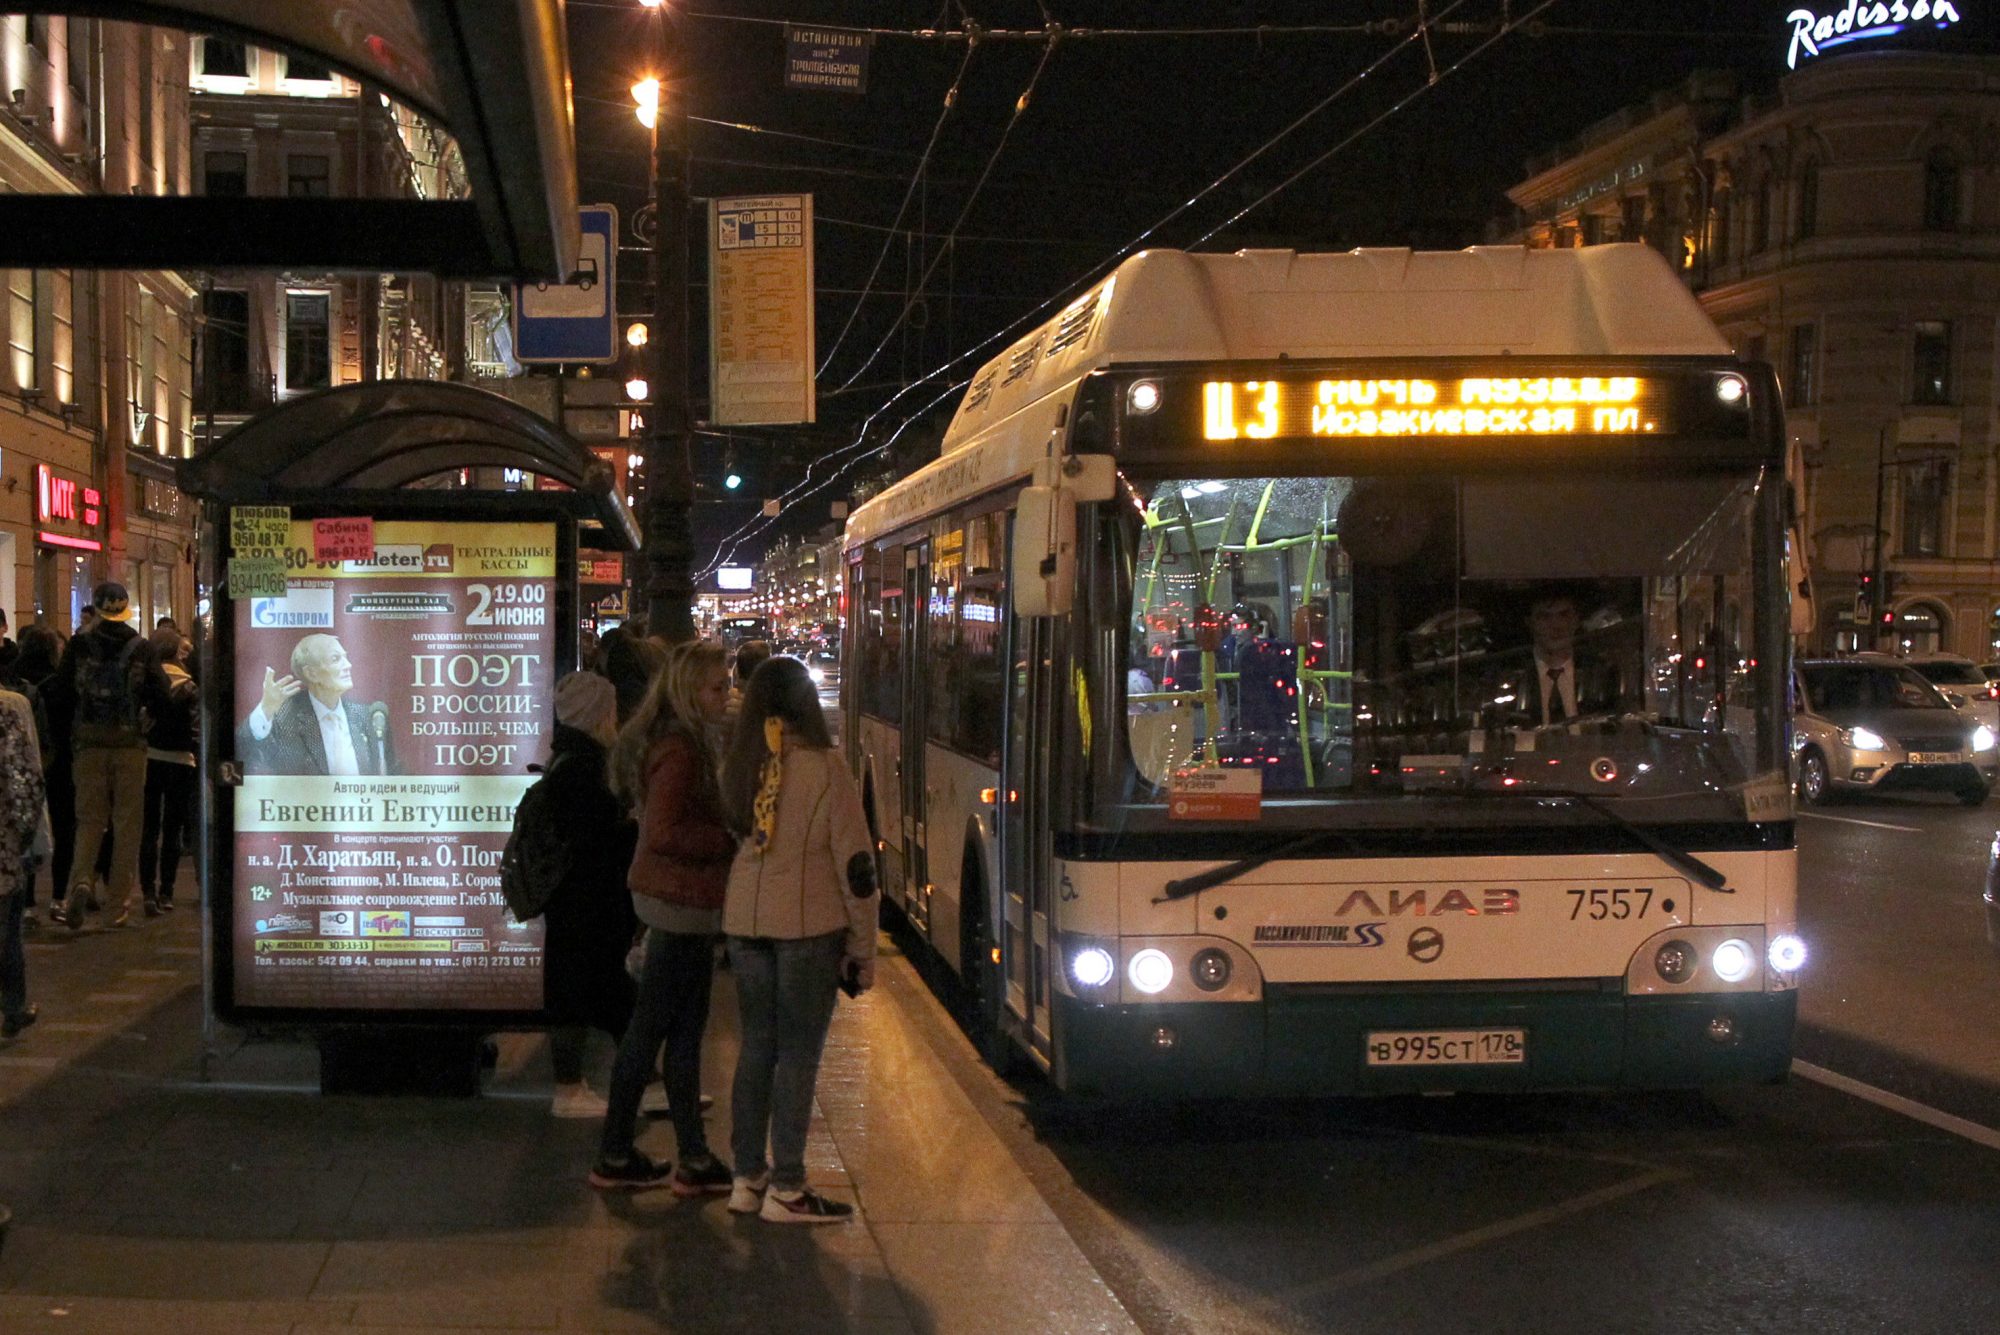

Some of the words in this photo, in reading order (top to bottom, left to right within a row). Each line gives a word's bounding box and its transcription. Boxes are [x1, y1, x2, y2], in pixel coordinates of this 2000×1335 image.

[1787, 0, 1960, 70] Radisson
[785, 211, 796, 220] 10
[784, 236, 796, 245] 22
[51, 477, 76, 520] МТС
[316, 522, 369, 533] Сабина
[235, 533, 255, 546] 950
[258, 533, 271, 546] 48
[457, 546, 554, 558] ТЕАТРАЛЬНЫЕ
[480, 558, 529, 571] КАССЫ
[230, 572, 286, 594] 9344066
[360, 597, 420, 605] КОНЦЕРТНЫЙ
[422, 597, 440, 605] ЗАЛ
[494, 584, 546, 603] 19.00
[465, 583, 493, 626] 2
[276, 611, 330, 626] ГАЗПРОМ
[494, 607, 546, 626] ИЮНЯ
[464, 632, 502, 641] РУССКОЙ
[410, 654, 541, 688] ПОЭТ
[410, 695, 426, 714] В
[431, 694, 542, 714] РОССИИ-
[499, 721, 541, 736] ЧЕМ
[434, 744, 518, 766] ПОЭТ
[333, 782, 367, 795] Автор
[370, 784, 397, 795] идеи
[400, 784, 407, 793] и
[410, 782, 461, 796] ведущий
[258, 798, 374, 823] Евгений
[334, 834, 340, 843] В
[248, 856, 261, 867] н.
[263, 857, 274, 867] а.
[277, 845, 298, 869] Д.
[302, 845, 402, 872] Харатьян,
[406, 856, 419, 867] н.
[421, 857, 432, 867] а.
[436, 844, 457, 867] О.
[280, 874, 293, 888] Д.
[296, 873, 383, 889] Константинов,
[386, 873, 401, 887] М.
[403, 874, 450, 889] Ивлева,
[452, 873, 463, 887] Е.
[250, 886, 273, 901] 12+
[283, 893, 363, 909] Музыкальное
[365, 895, 457, 909] сопровождение
[459, 892, 487, 906] Глеб
[1333, 889, 1521, 917] ЛИАЗ
[1566, 888, 1654, 921] 7557
[414, 928, 452, 936] НЕВСКОЕ
[455, 928, 483, 936] ВРЕМЯ
[1254, 925, 1351, 942] ПАССАЖИРАВТОТРАНС
[254, 956, 276, 966] Тел.
[279, 957, 315, 966] кассы:
[317, 956, 337, 966] 542
[339, 956, 353, 966] 09
[374, 957, 417, 967] справки
[419, 957, 432, 966] по
[434, 957, 460, 967] тел.:
[462, 956, 488, 968] (812)
[491, 957, 510, 966] 273
[513, 957, 526, 966] 02
[529, 957, 541, 966] 17
[1377, 1036, 1474, 1061] В995СТ
[1481, 1034, 1517, 1053] 178
